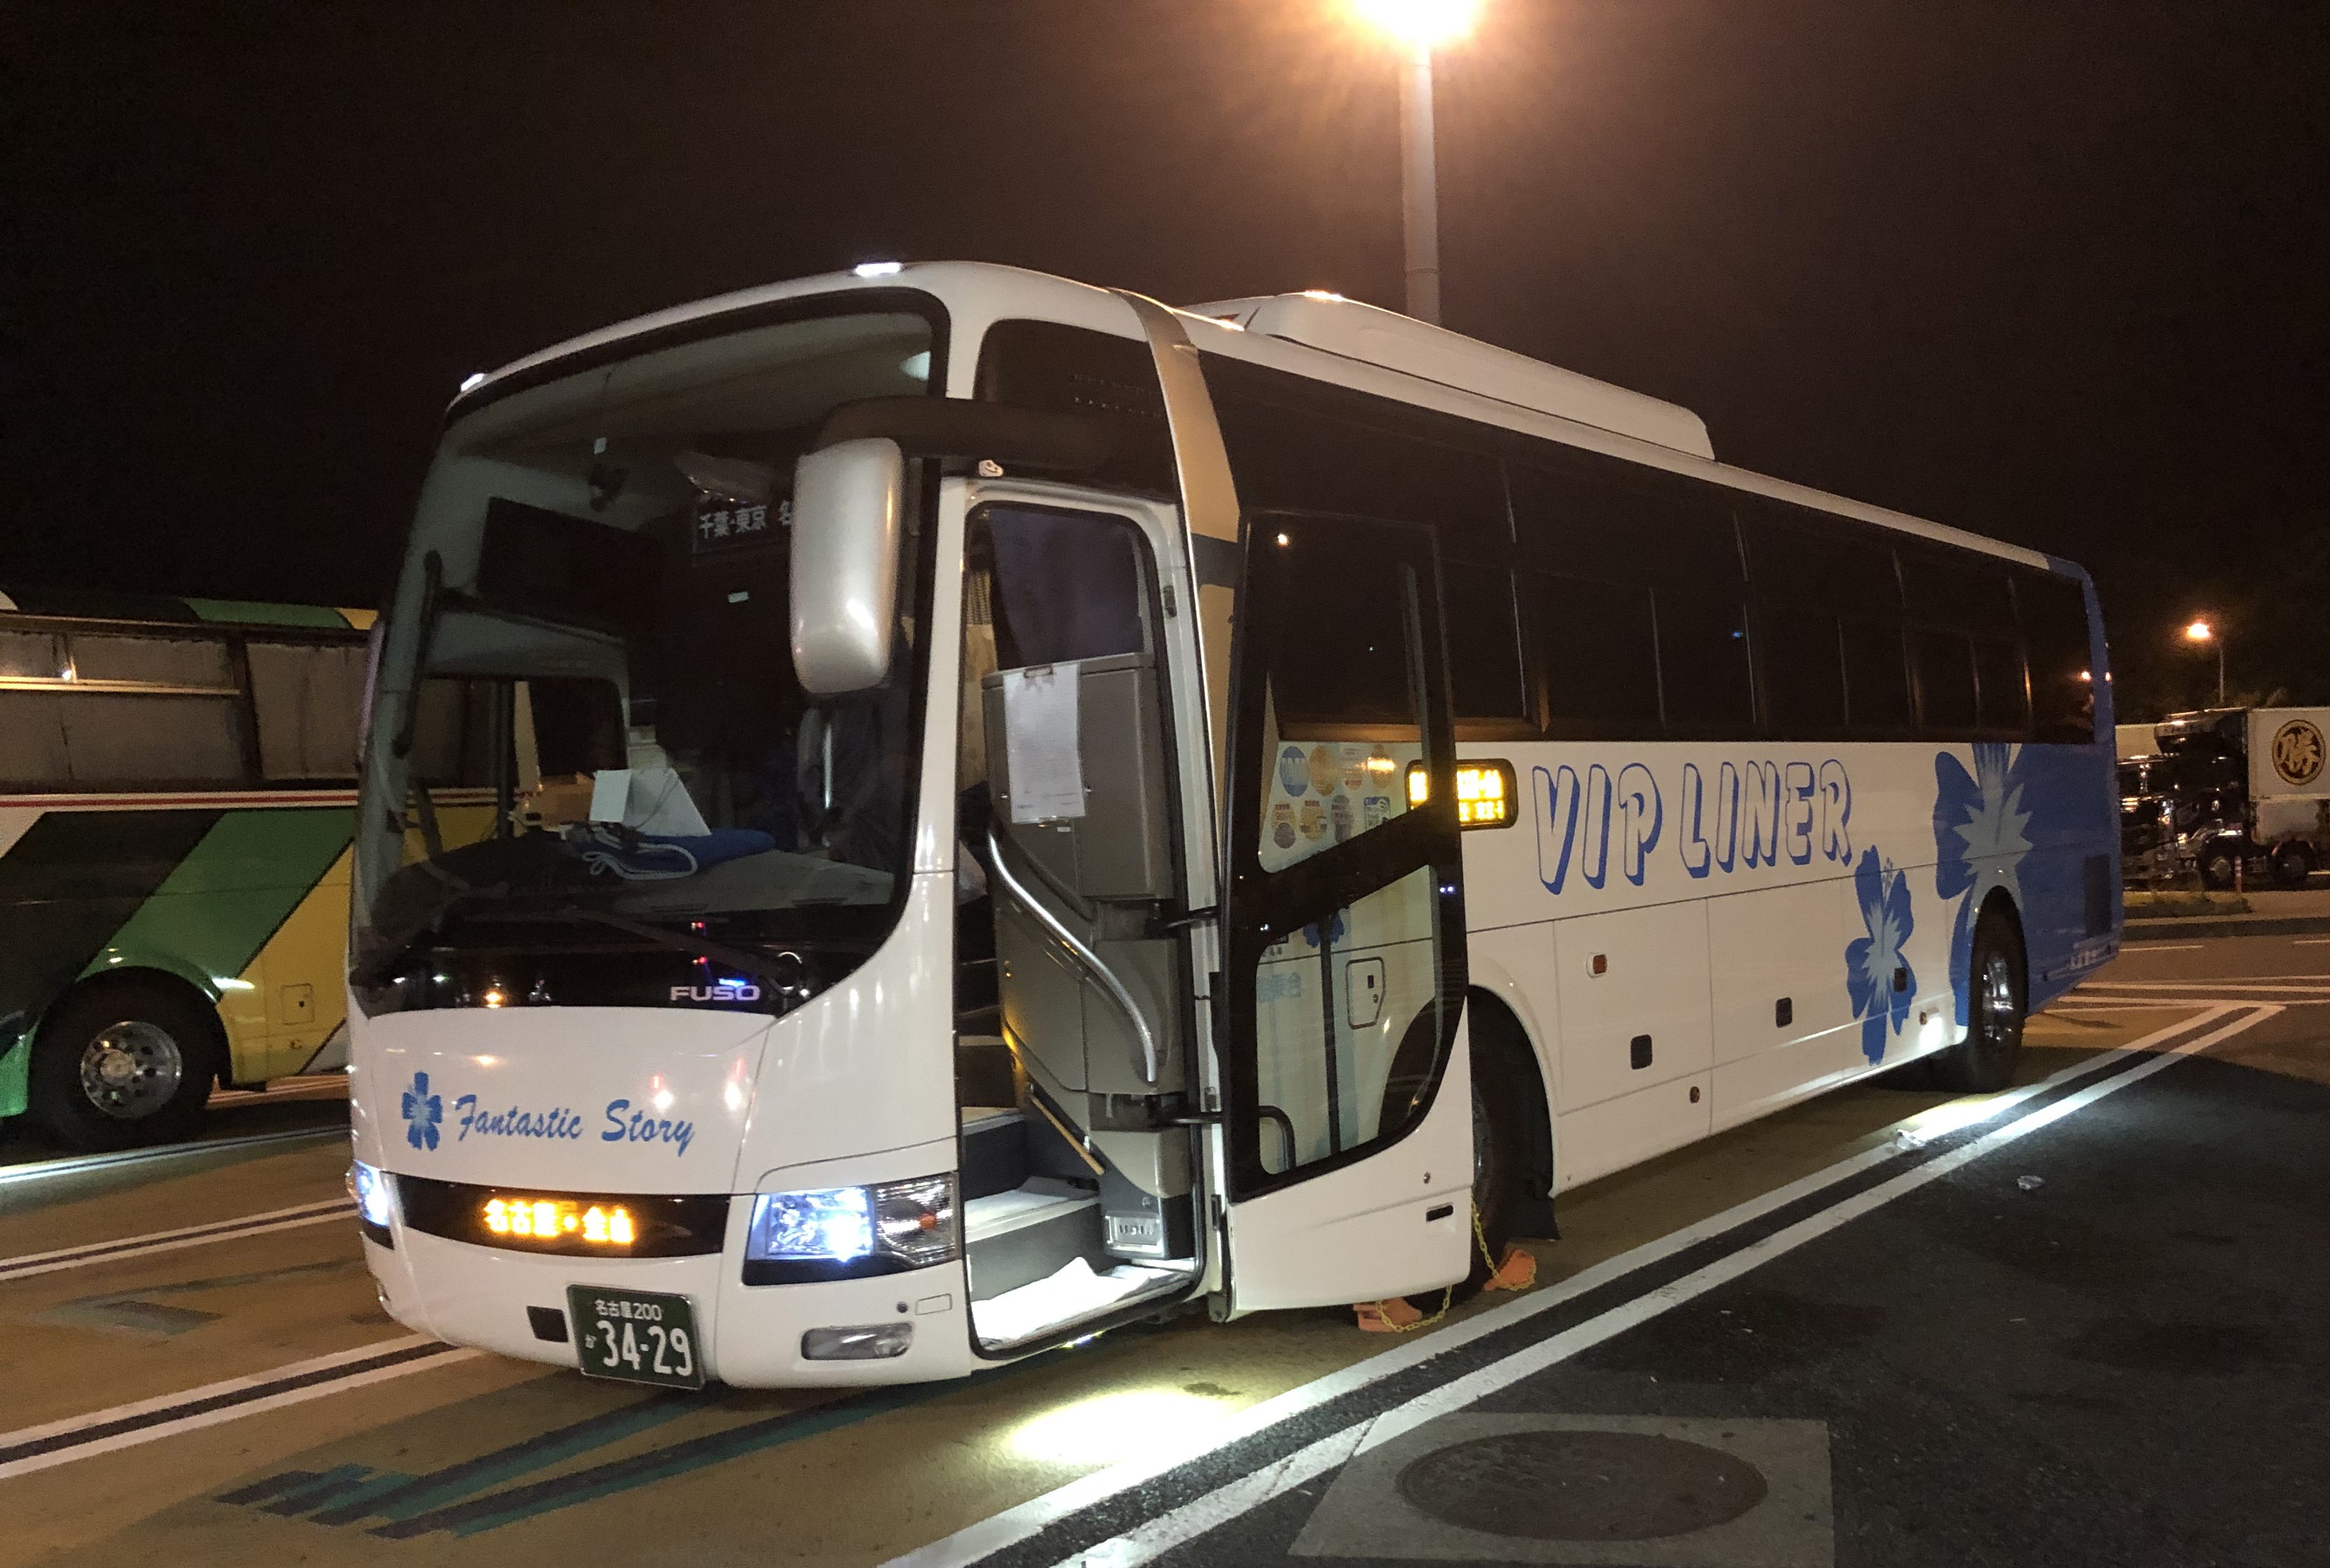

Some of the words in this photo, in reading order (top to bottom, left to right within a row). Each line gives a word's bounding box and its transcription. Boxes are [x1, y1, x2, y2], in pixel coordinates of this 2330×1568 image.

[1531, 762, 1663, 896] VIP
[1679, 758, 1853, 880] LINER
[669, 984, 761, 1002] FUSO
[454, 1093, 584, 1142] Fantastic
[600, 1098, 696, 1157] Story
[596, 1320, 693, 1377] 34-29
